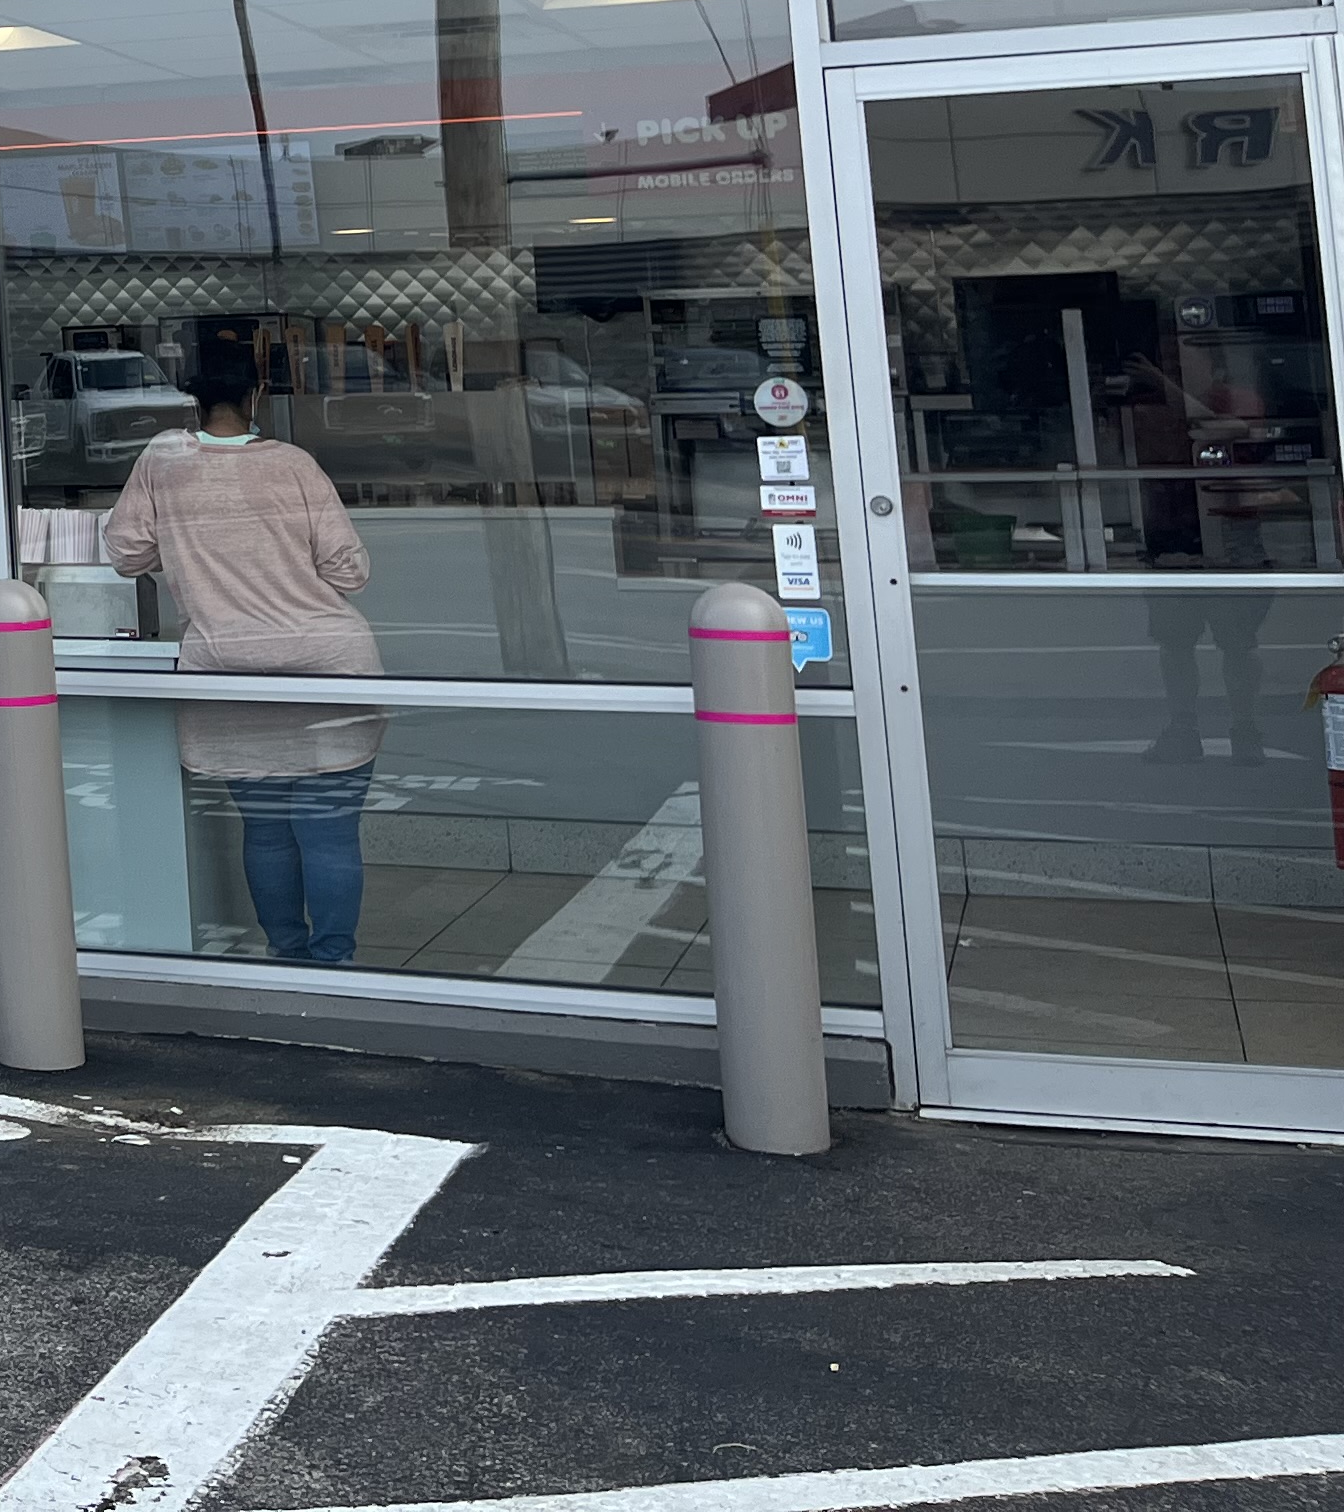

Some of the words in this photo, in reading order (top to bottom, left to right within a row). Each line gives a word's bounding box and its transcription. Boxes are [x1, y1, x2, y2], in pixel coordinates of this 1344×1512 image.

[636, 116, 726, 147] PICK
[736, 113, 787, 140] UP
[638, 172, 711, 190] MOBILE
[716, 168, 795, 186] ORDERS
[777, 494, 808, 502] OMNI
[788, 576, 811, 586] VISA
